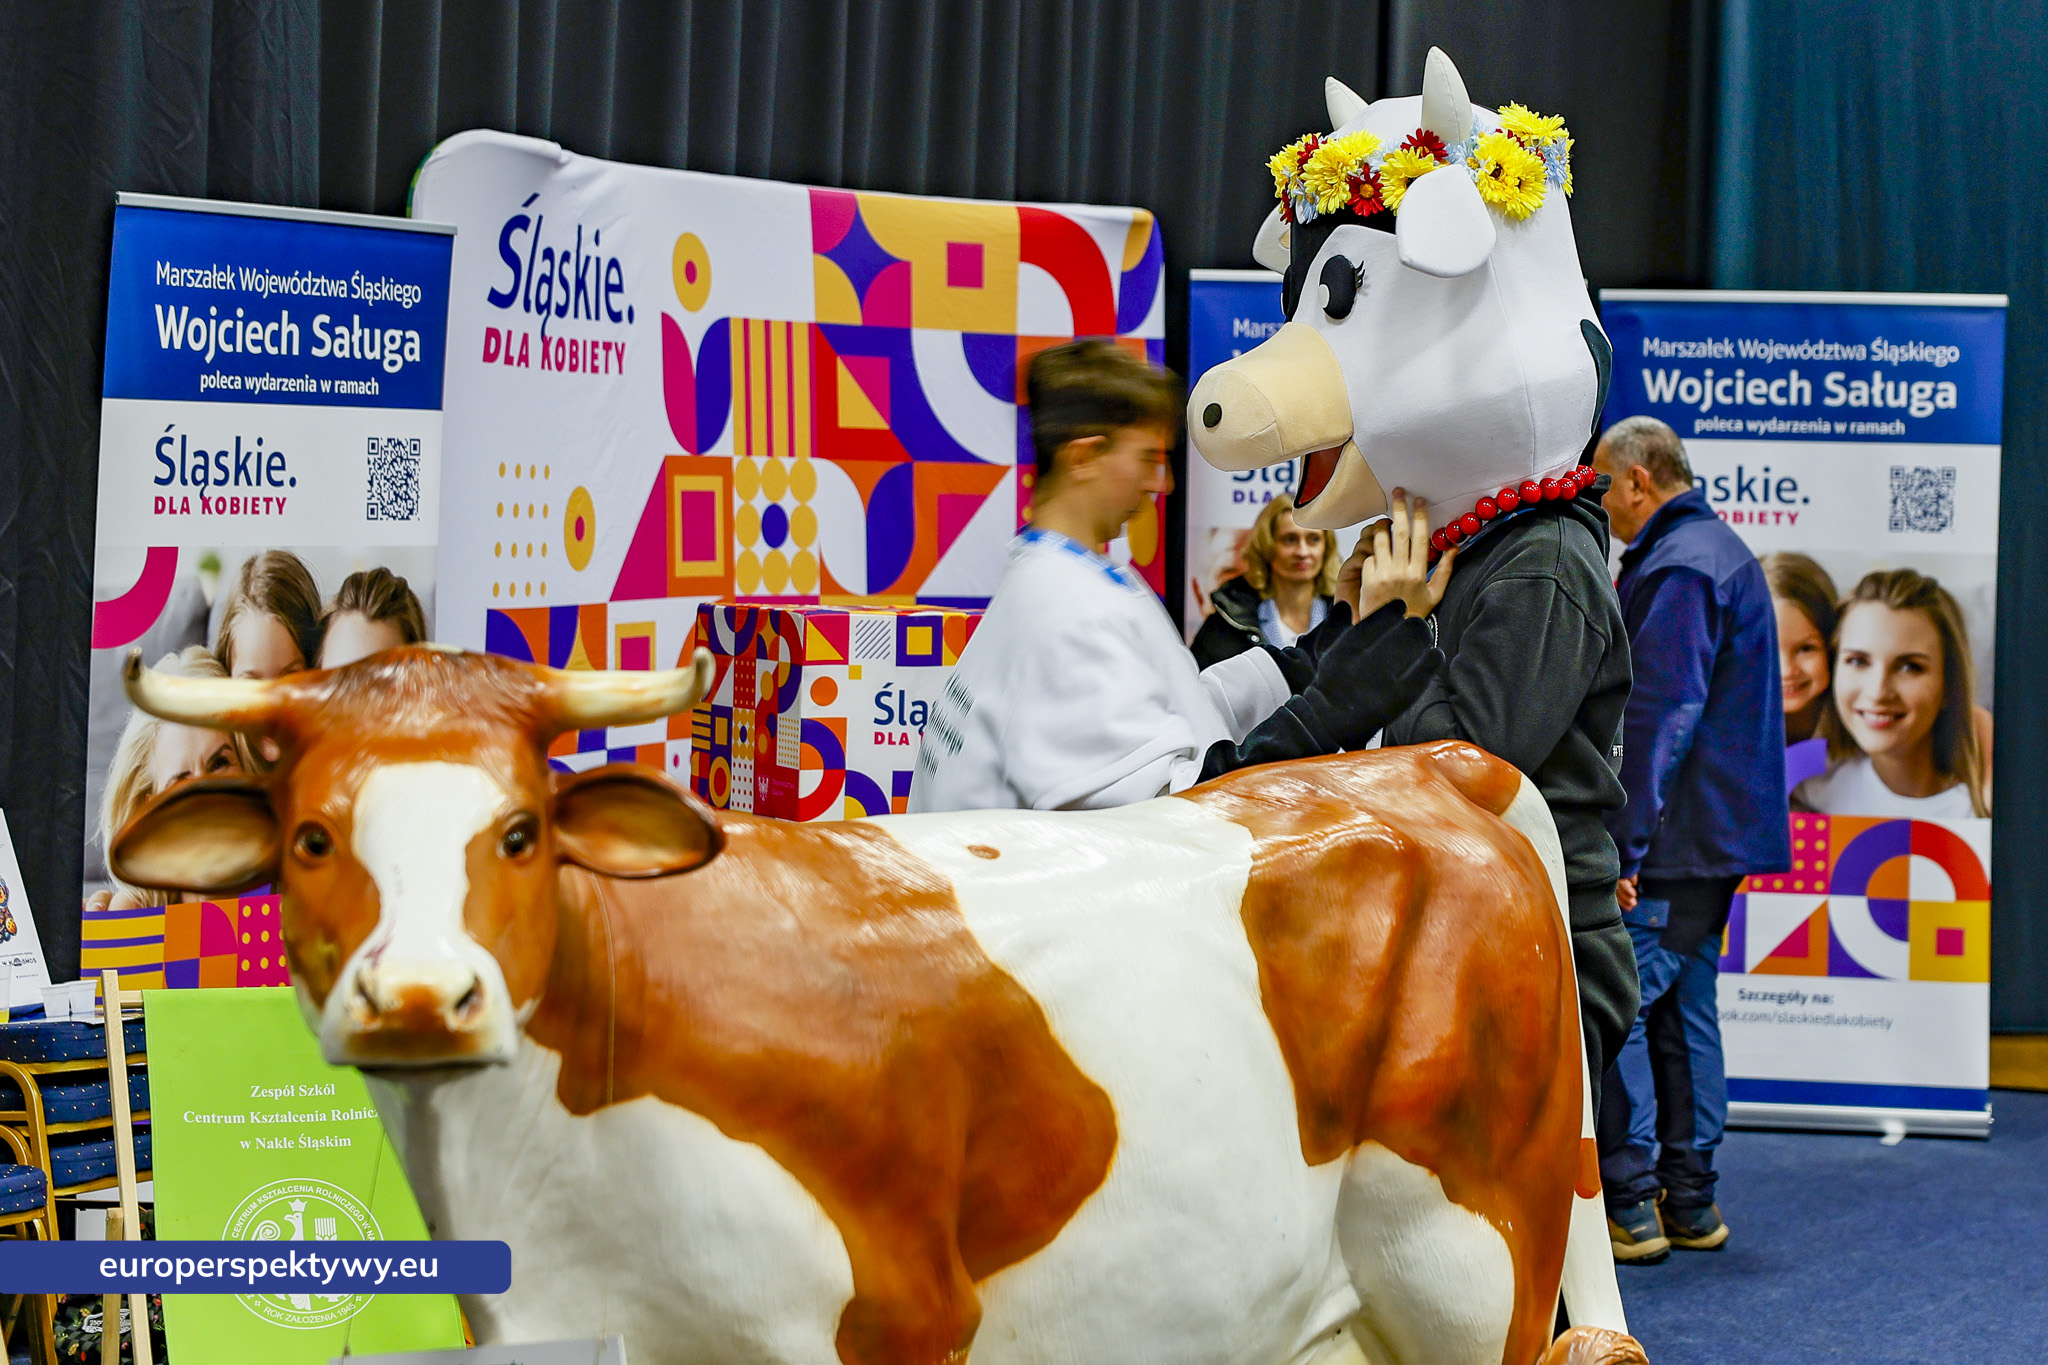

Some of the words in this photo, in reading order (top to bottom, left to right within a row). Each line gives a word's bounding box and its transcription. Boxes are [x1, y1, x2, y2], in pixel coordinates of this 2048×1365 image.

[486, 192, 635, 343] Śląskie.
[156, 260, 236, 291] Marszałek
[239, 266, 348, 299] Województwa
[351, 270, 422, 309] Śląskiego
[155, 304, 300, 364] Wojciech
[311, 313, 421, 373] Saługa
[482, 326, 530, 369] DLA
[541, 334, 626, 375] KOBIETY
[1737, 338, 1867, 364] Województwa
[1870, 336, 1960, 368] Śląskiego
[200, 370, 242, 393] poleca
[244, 372, 317, 395] wydarzenia
[320, 380, 332, 392] w
[334, 376, 380, 396] ramach
[1642, 368, 1812, 413] Wojciech
[1824, 370, 1958, 418] Saługa
[1694, 415, 1744, 435] poleca
[1746, 417, 1832, 436] wydarzenia
[1834, 423, 1847, 434] w
[1850, 418, 1906, 436] ramach
[153, 424, 297, 500] Śląskie.
[154, 496, 191, 515] DLA
[201, 496, 288, 516] KOBIETY
[1716, 510, 1799, 526] OBIETY
[874, 731, 910, 746] DLA
[1737, 987, 1809, 1005] Szczegóły
[250, 1083, 295, 1100] Zespół
[298, 1083, 336, 1097] Szkół
[183, 1110, 246, 1124] Centrum
[249, 1109, 327, 1124] Kształcenia
[240, 1140, 251, 1150] w
[255, 1137, 295, 1150] Nakle
[298, 1133, 352, 1151] Śląskim
[231, 1201, 258, 1239] CENTRUM
[256, 1184, 314, 1204] KSZTAŁCENIA
[315, 1186, 365, 1222] ROLNICZEGO
[263, 1306, 283, 1320] ROK
[284, 1313, 337, 1324] ZAŁOŻENIA
[337, 1302, 356, 1317] 1945
